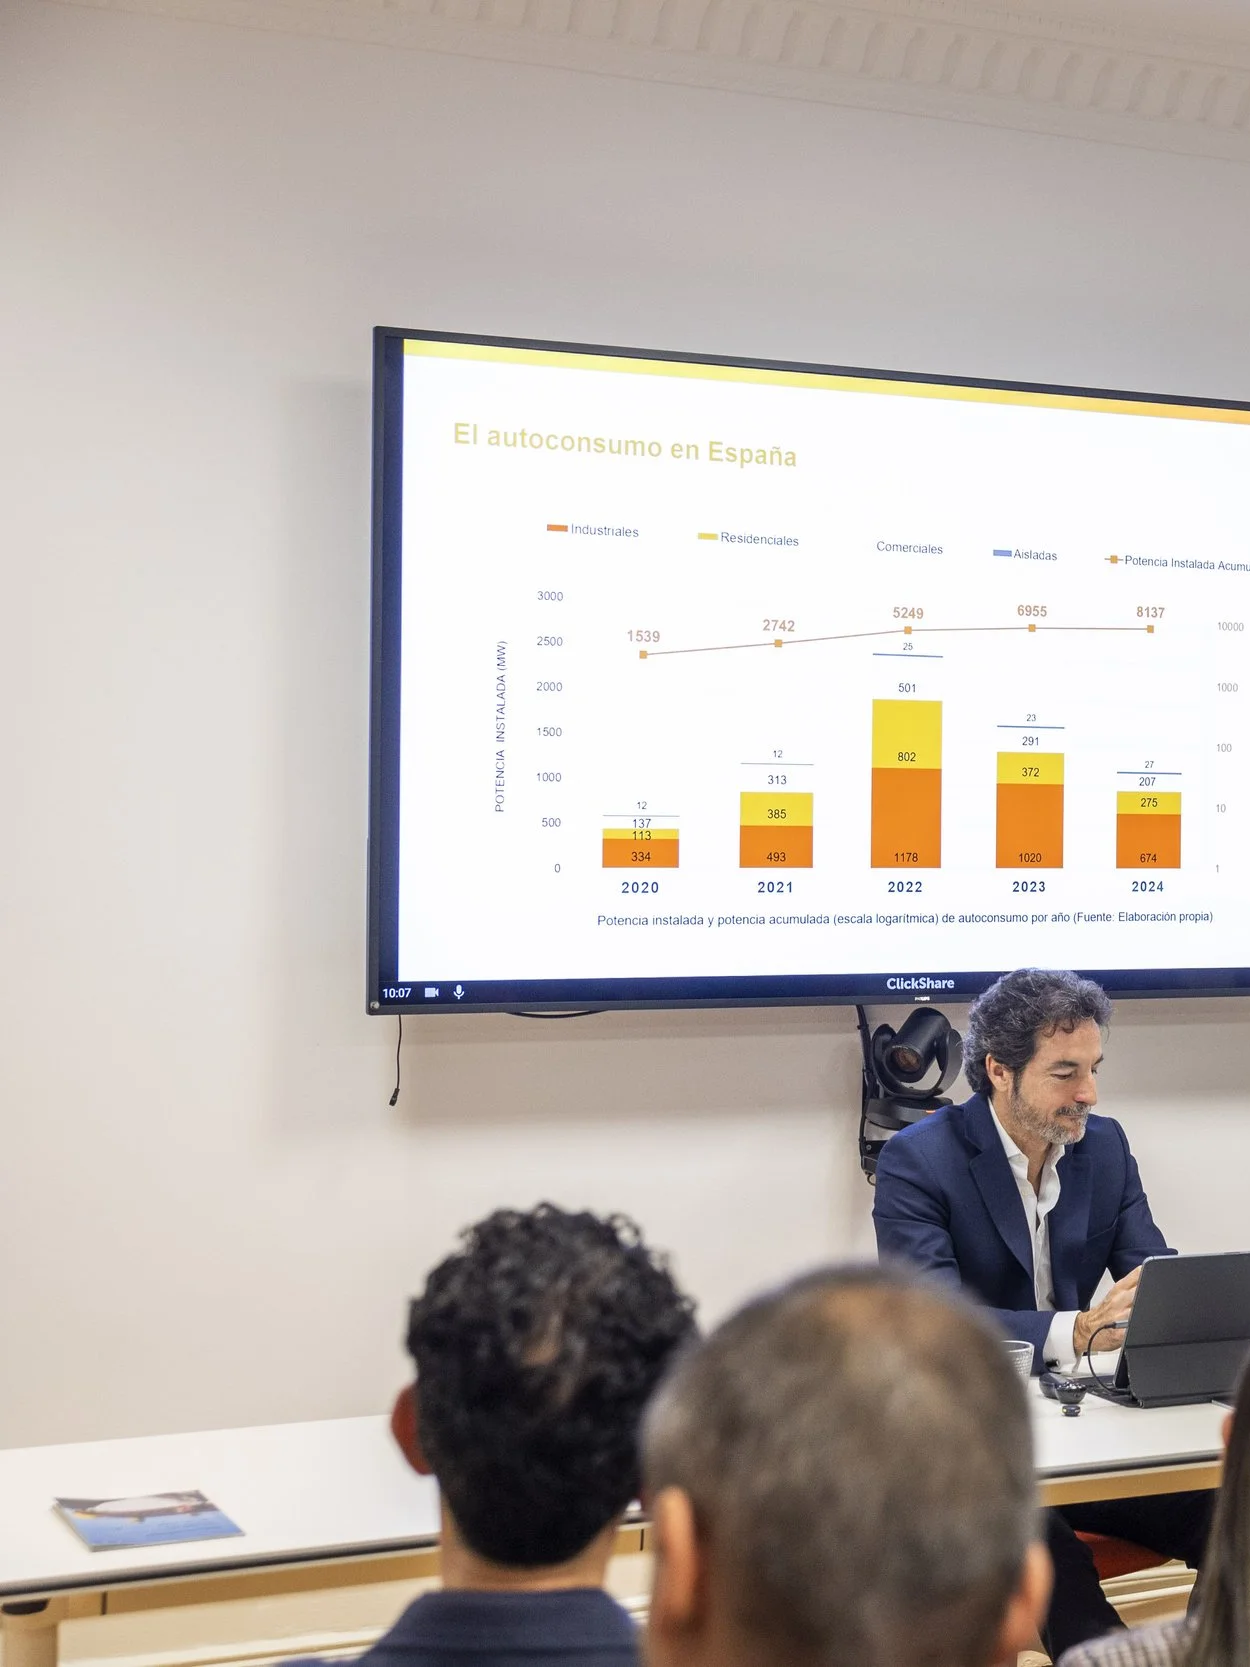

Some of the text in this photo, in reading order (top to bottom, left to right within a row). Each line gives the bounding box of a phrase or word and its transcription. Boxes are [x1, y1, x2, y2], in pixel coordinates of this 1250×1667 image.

[454, 422, 797, 469] El autoconsumo en España
[571, 523, 639, 538] Industriales
[720, 531, 799, 547] Residenciales
[876, 540, 944, 555] Comerciales
[1013, 548, 1058, 561] Aisladas
[1124, 554, 1168, 567] Potencia
[1171, 557, 1215, 570] Instalada
[537, 590, 564, 602] 3000
[892, 606, 924, 620] 5249
[1016, 604, 1048, 618] 6955
[1136, 605, 1166, 619] 8137
[762, 618, 795, 633] 2742
[1217, 621, 1245, 632] 10000
[536, 635, 564, 647] 2500
[627, 629, 661, 643] 1539
[902, 642, 914, 651] 25
[536, 681, 563, 692] 2000
[898, 682, 916, 693] 501
[1217, 682, 1239, 693] 1000
[1026, 713, 1037, 722] 23
[494, 640, 508, 813] POTENCIA INSTALADA (MW)
[536, 726, 563, 737] 1500
[1021, 735, 1039, 746] 291
[1216, 743, 1233, 753] 100
[773, 749, 783, 759] 12
[897, 751, 917, 762] 802
[1144, 760, 1155, 769] 27
[536, 771, 562, 783] 1000
[1021, 766, 1040, 778] 372
[767, 774, 787, 785] 313
[1139, 776, 1156, 786] 207
[636, 801, 648, 810] 12
[1140, 797, 1158, 808] 275
[767, 808, 787, 820] 385
[1216, 803, 1227, 814] 10
[541, 817, 562, 828] 500
[633, 818, 651, 828] 137
[632, 830, 652, 841] 113
[631, 851, 651, 862] 334
[766, 851, 787, 863] 493
[894, 852, 919, 863] 1178
[1018, 852, 1042, 863] 1020
[1139, 853, 1158, 864] 674
[554, 863, 561, 874] 0
[1215, 863, 1220, 873] 1
[621, 881, 659, 894] 2020
[757, 881, 792, 894] 2021
[887, 880, 923, 893] 2022
[1012, 880, 1046, 893] 2023
[1131, 880, 1164, 893] 2024
[597, 911, 1213, 928] Potencia instalada y potencia acumulada (escala logarítmica) de autoconsumo por año (Fuente: Elaboración propia)
[886, 976, 955, 990] ClickShare
[382, 987, 412, 999] 10:07
